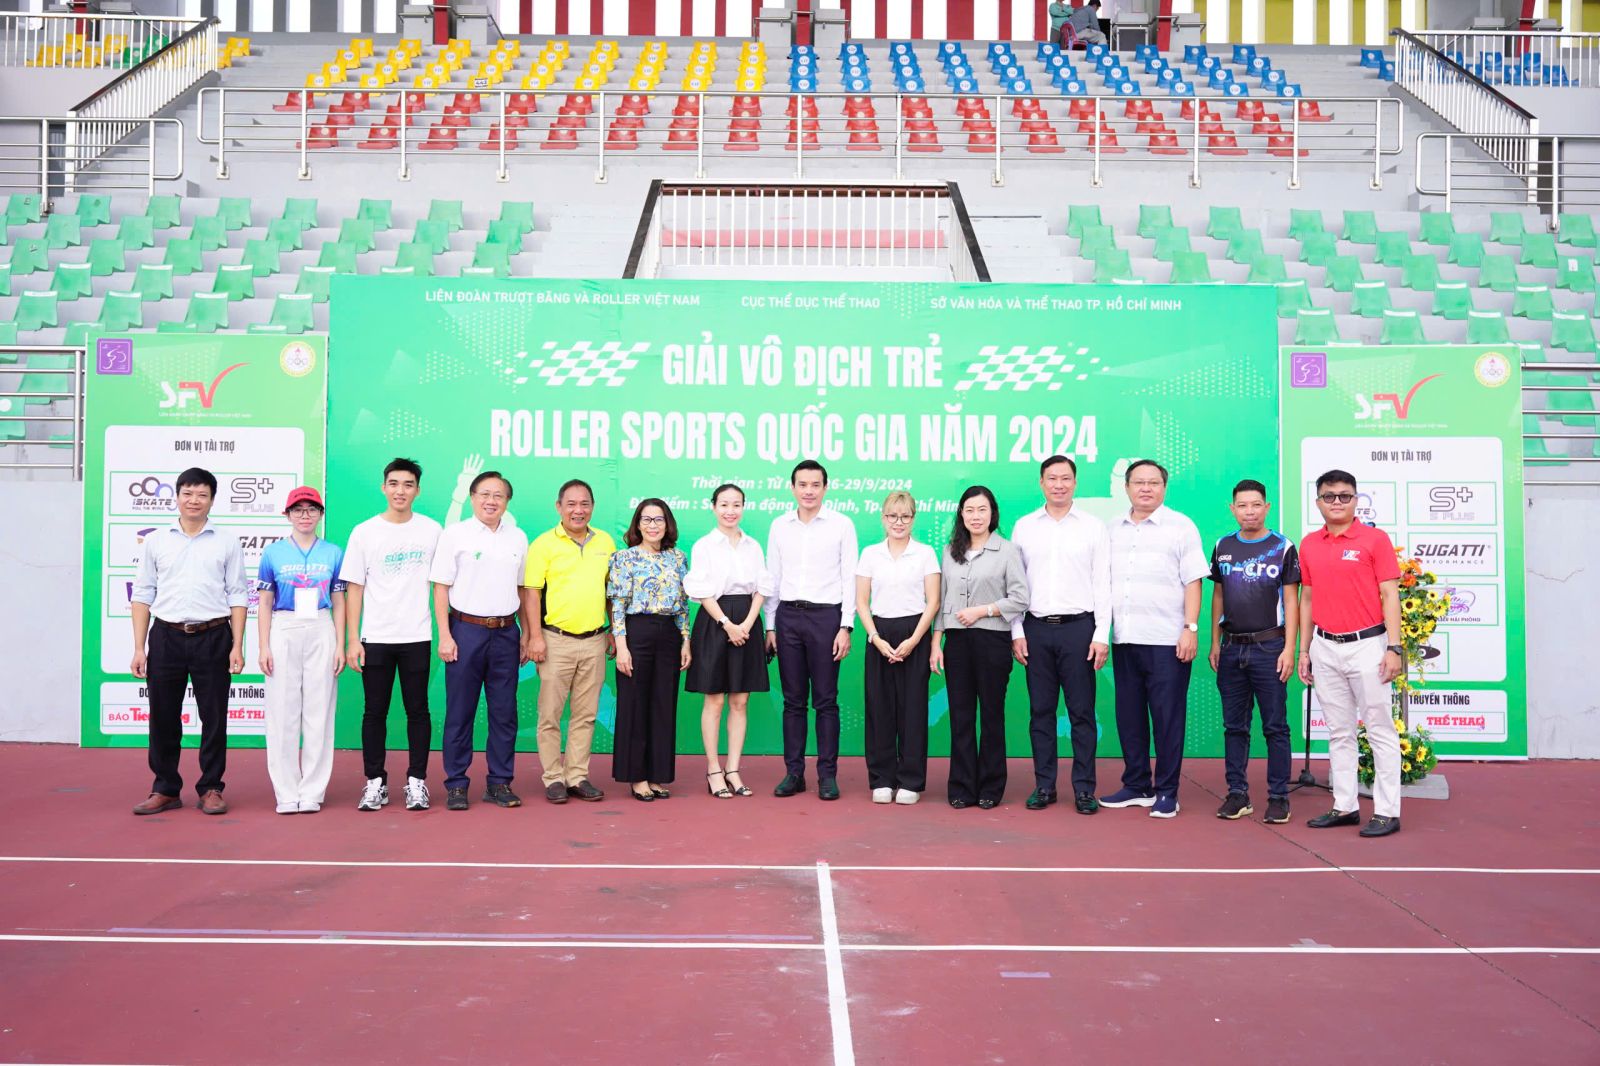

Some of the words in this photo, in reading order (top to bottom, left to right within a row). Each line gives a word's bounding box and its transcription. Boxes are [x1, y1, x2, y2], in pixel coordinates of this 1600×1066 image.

[425, 289, 452, 302] LIÊN
[456, 290, 490, 303] ĐOÀN
[493, 291, 534, 306] TRƯỢT
[537, 290, 570, 304] BĂNG
[574, 290, 590, 304] VÀ
[593, 294, 640, 305] ROLLER
[644, 292, 669, 308] VIỆT
[672, 295, 700, 306] NAM
[741, 297, 766, 310] CỤC
[768, 292, 792, 308] THỂ
[795, 298, 819, 310] DỤC
[822, 293, 846, 308] THỂ
[849, 298, 880, 309] THAO
[950, 296, 975, 309] VĂN
[978, 296, 1003, 309] HÓA
[1006, 297, 1022, 310] VÀ
[1024, 295, 1048, 310] THỂ
[1051, 300, 1082, 310] THAO
[1086, 300, 1104, 310] TP.
[1106, 296, 1123, 311] HỒ
[1126, 296, 1147, 311] CHÍ
[1150, 301, 1182, 311] MINH
[662, 331, 728, 386] GIẢI
[740, 335, 783, 387] VÔ
[793, 346, 872, 396] ĐỊCH
[883, 333, 943, 388] TRẺ
[490, 408, 610, 458] ROLLER
[621, 411, 746, 460] SPORTS
[757, 403, 844, 464] QUỐC
[855, 414, 909, 461] GIA
[920, 403, 998, 462] NĂM
[1009, 415, 1098, 462] 2024
[174, 439, 192, 452] ĐƠN
[194, 440, 202, 454] VỊ
[204, 438, 218, 452] TÀI
[220, 440, 235, 454] TRỢ
[1371, 449, 1388, 462] ĐƠN
[1390, 450, 1399, 463] VỊ
[1401, 448, 1414, 462] TÀI
[1416, 449, 1432, 463] TRỢ
[1413, 544, 1486, 557] SUGATTI
[238, 685, 265, 699] THÔNG
[1443, 692, 1470, 705] THÔNG
[108, 710, 130, 721] BÁO
